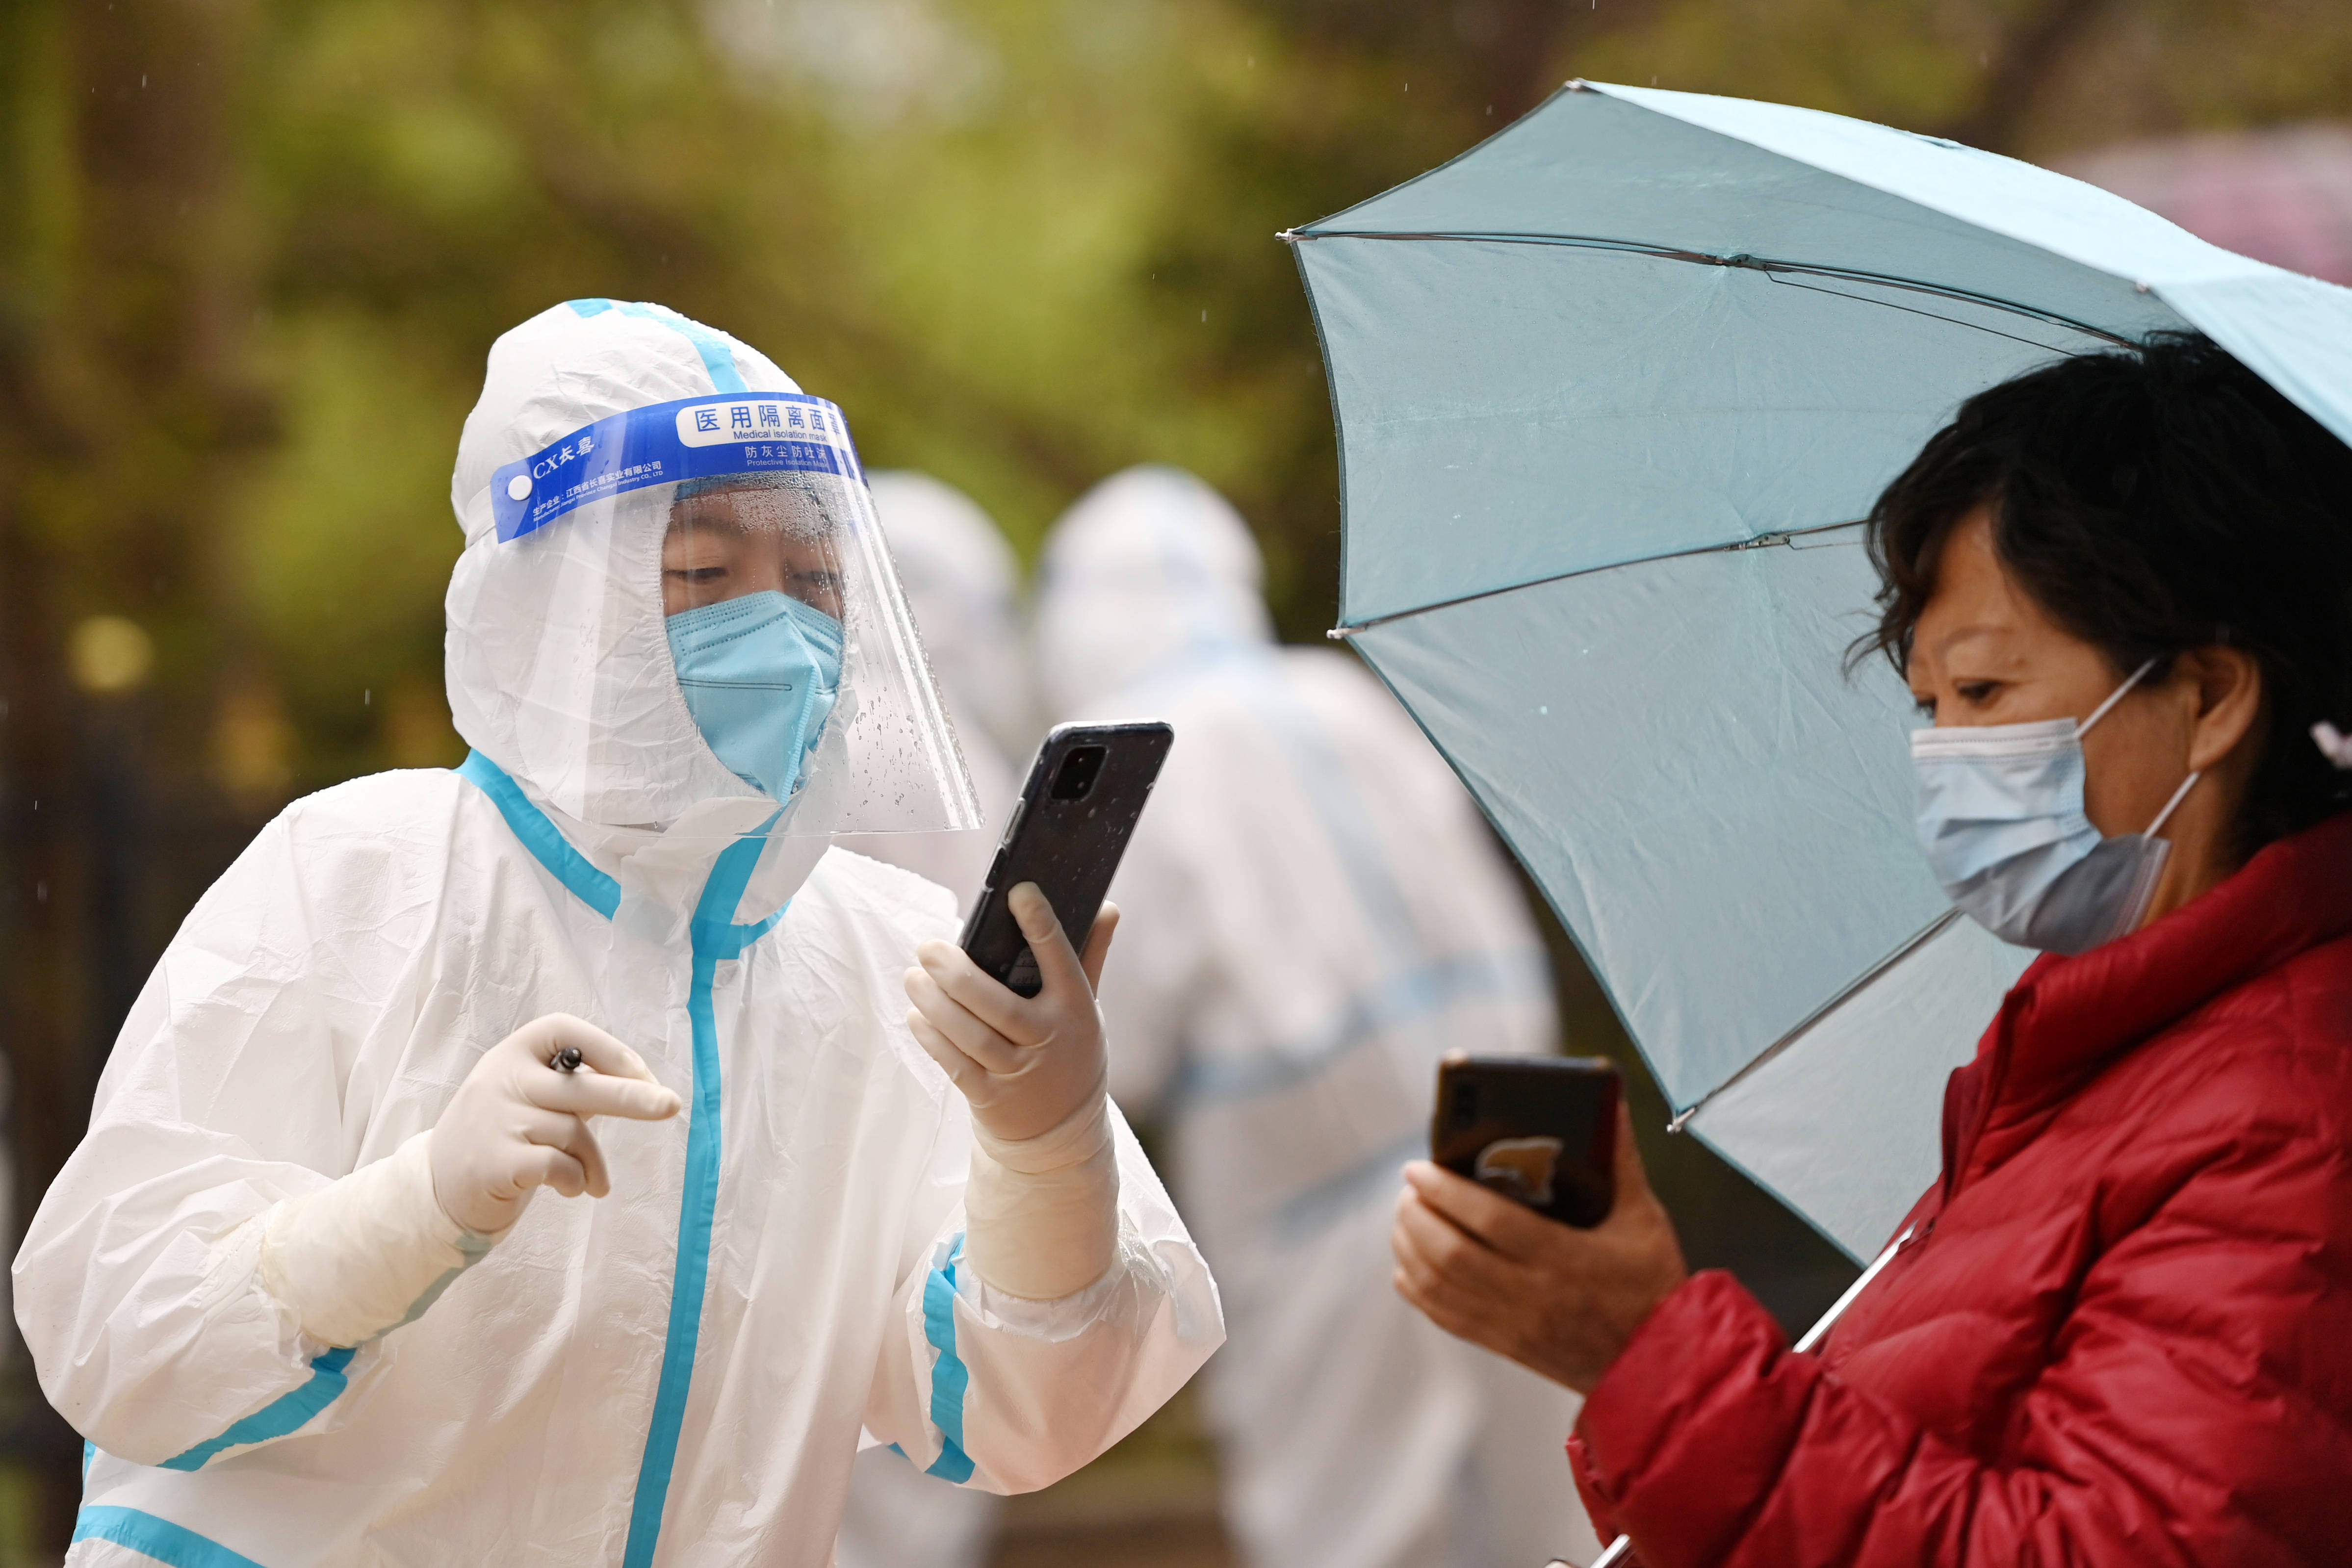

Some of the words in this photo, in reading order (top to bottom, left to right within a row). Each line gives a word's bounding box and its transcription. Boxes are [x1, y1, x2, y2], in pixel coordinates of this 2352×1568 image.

[733, 429, 771, 440] Medical
[773, 430, 807, 439] isolation
[809, 432, 827, 442] mask
[576, 488, 596, 500] Province
[596, 481, 618, 491] Changxi
[618, 476, 640, 486] Industry
